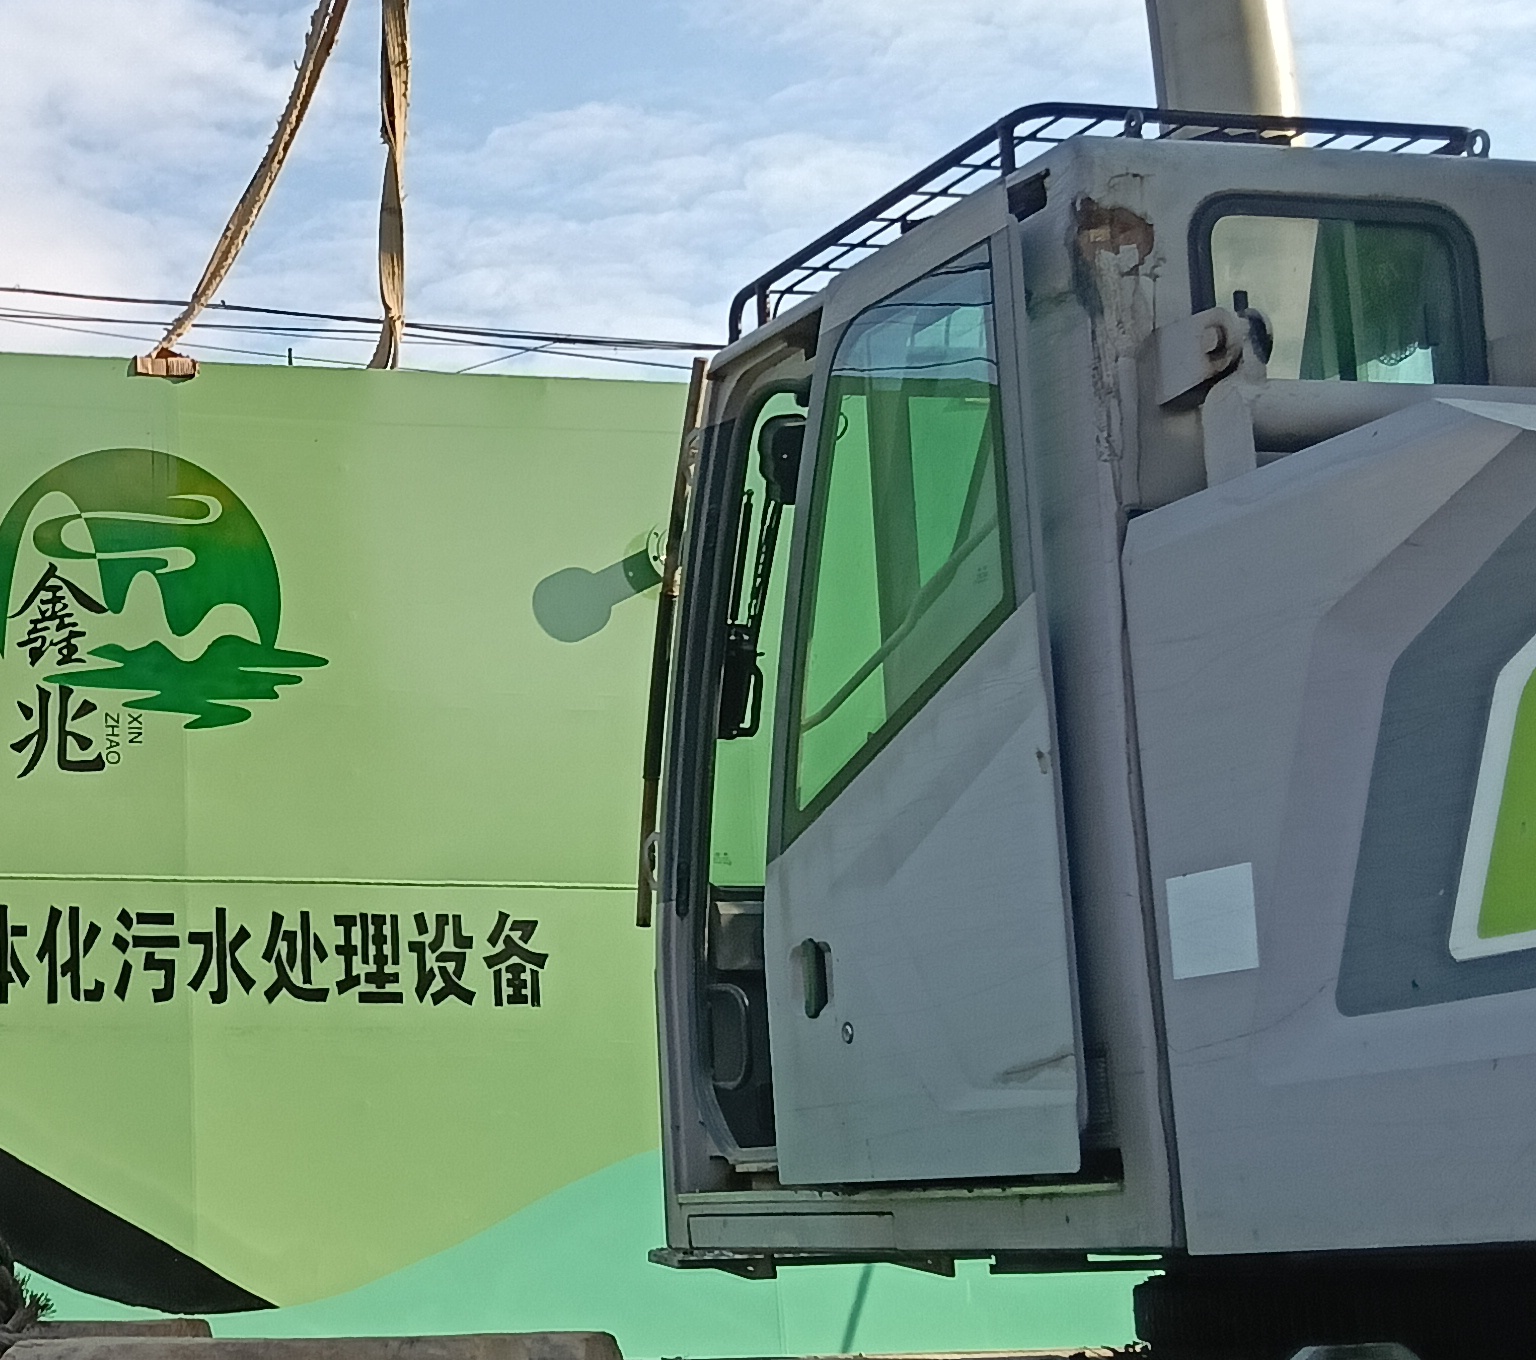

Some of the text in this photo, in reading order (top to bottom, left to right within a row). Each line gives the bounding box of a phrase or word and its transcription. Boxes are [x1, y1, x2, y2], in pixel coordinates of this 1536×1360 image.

[7, 561, 111, 779] 鑫兆
[104, 711, 121, 766] ZHAO
[127, 711, 144, 745] XIN
